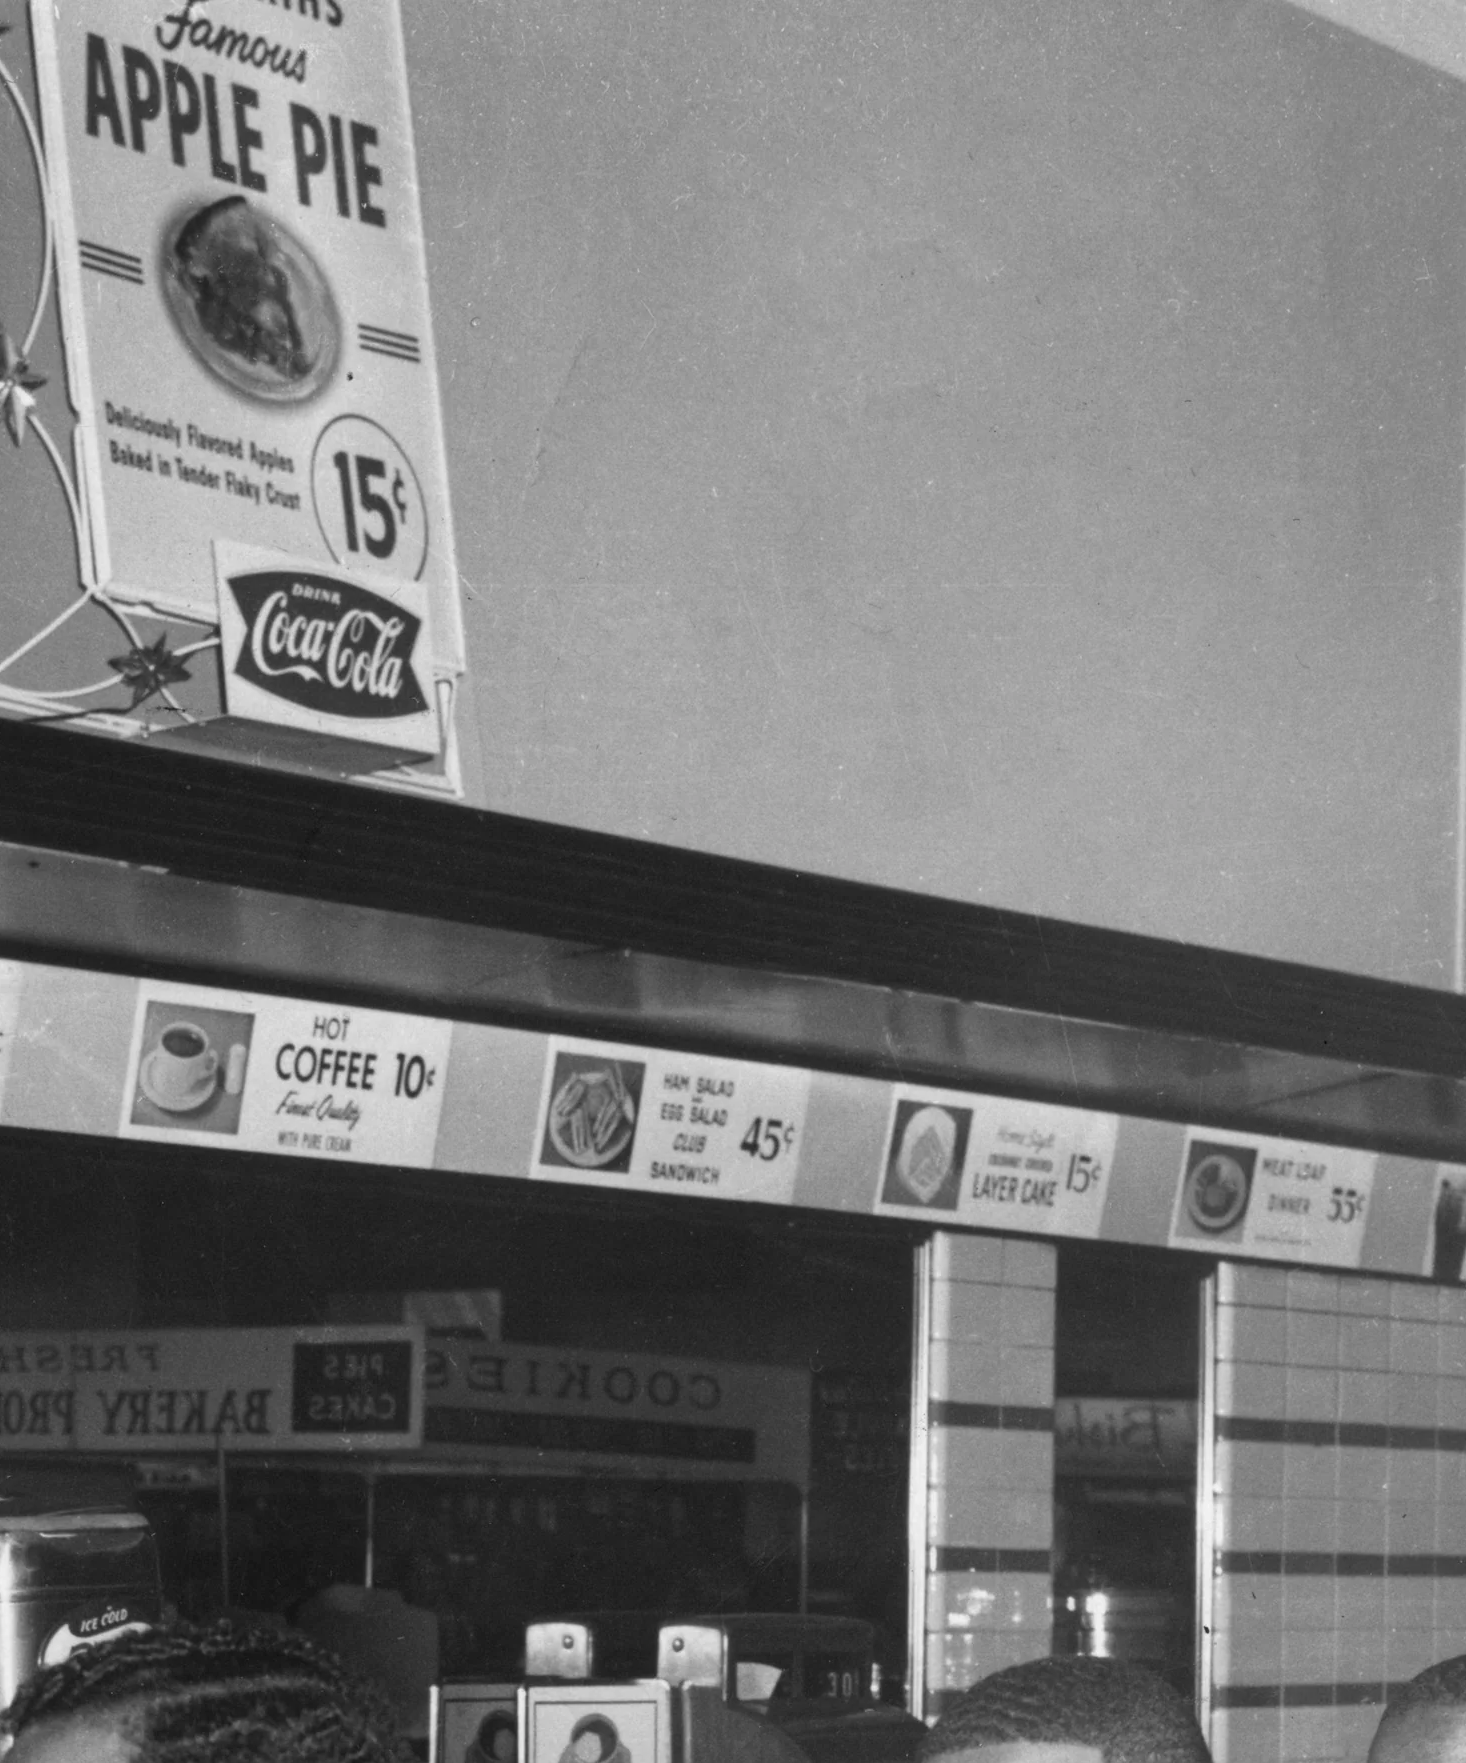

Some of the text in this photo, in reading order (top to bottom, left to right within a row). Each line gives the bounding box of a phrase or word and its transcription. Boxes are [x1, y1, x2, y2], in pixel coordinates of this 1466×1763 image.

[155, 0, 307, 84] Famous
[85, 32, 387, 229] APPLE PIE
[104, 400, 294, 474] Deliciously Flavored Apples
[109, 439, 301, 511] Baked in Tender Flaky Crust
[333, 451, 407, 559] 15¢
[292, 583, 342, 605] DRINK
[252, 590, 406, 699] Coca-Cola
[313, 1015, 351, 1040] HOT
[274, 1043, 377, 1091] COFFEE
[394, 1052, 436, 1099] 10¢
[664, 1073, 736, 1098] HAM SALAD
[316, 1093, 362, 1132] Quality
[660, 1102, 728, 1127] EGG SALAD
[277, 1130, 298, 1148] WITH
[672, 1132, 707, 1154] CLUB
[740, 1115, 795, 1161] 45¢
[650, 1161, 721, 1186] SANDWICH
[972, 1172, 1059, 1208] LAYER CAKE
[1066, 1153, 1103, 1194] 15¢
[80, 1606, 129, 1634] ICE COLD
